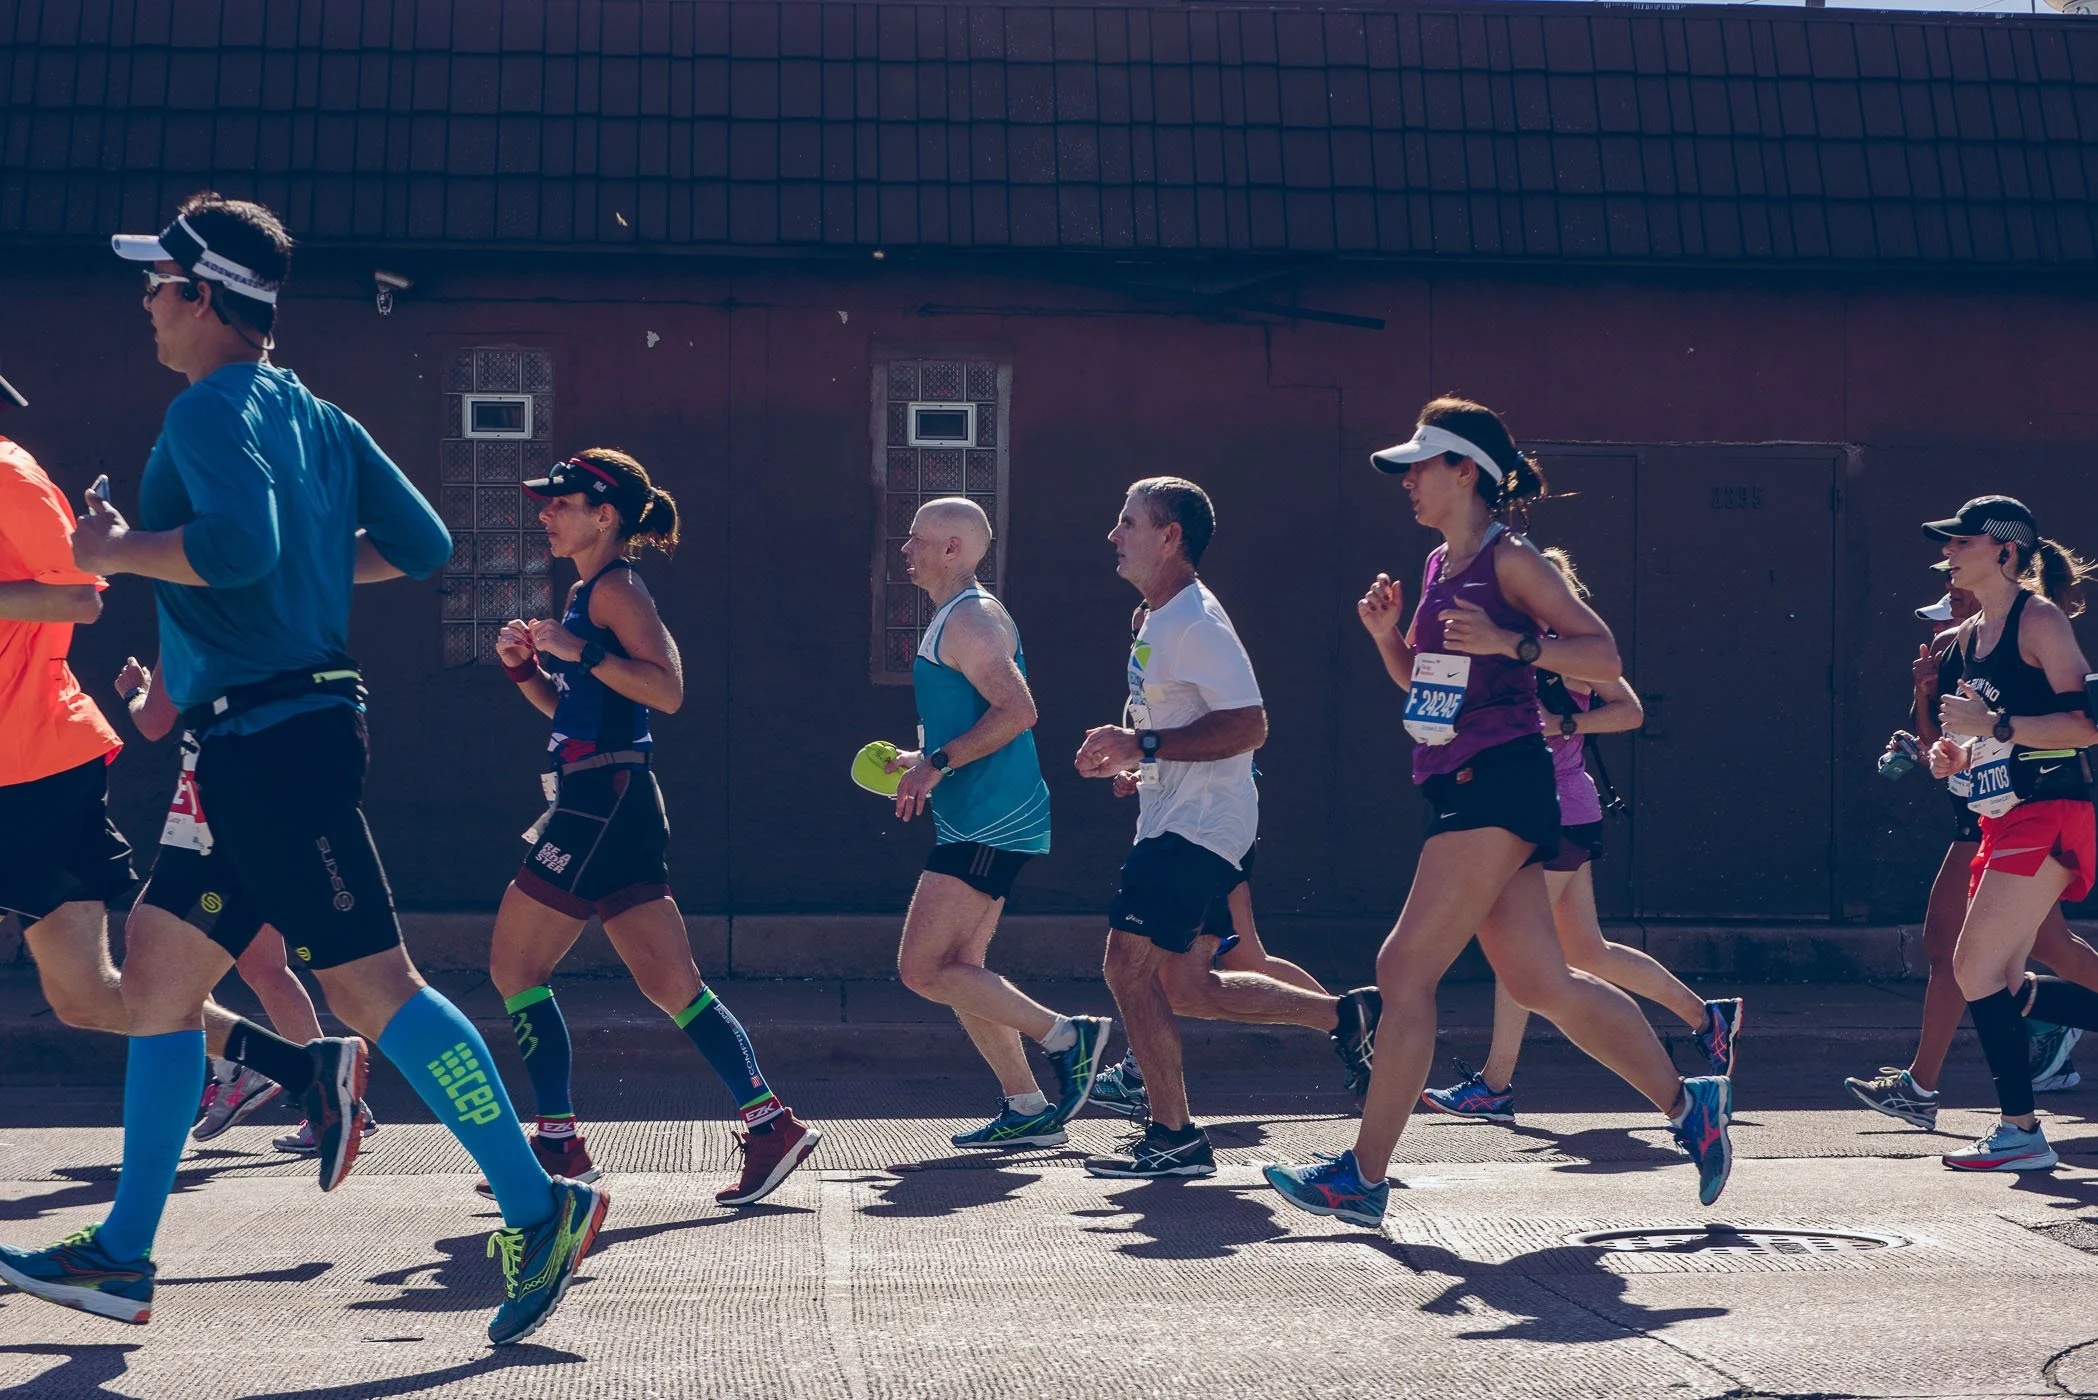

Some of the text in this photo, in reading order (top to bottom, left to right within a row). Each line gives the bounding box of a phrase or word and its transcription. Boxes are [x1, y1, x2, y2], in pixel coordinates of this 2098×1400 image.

[201, 258, 259, 289] ADSWEAT
[1982, 681, 2000, 702] TWO
[1405, 687, 1462, 718] F 24245
[1978, 764, 2010, 795] 21703
[535, 853, 565, 874] STER
[745, 1101, 777, 1121] EZK
[543, 1121, 574, 1132] EZK
